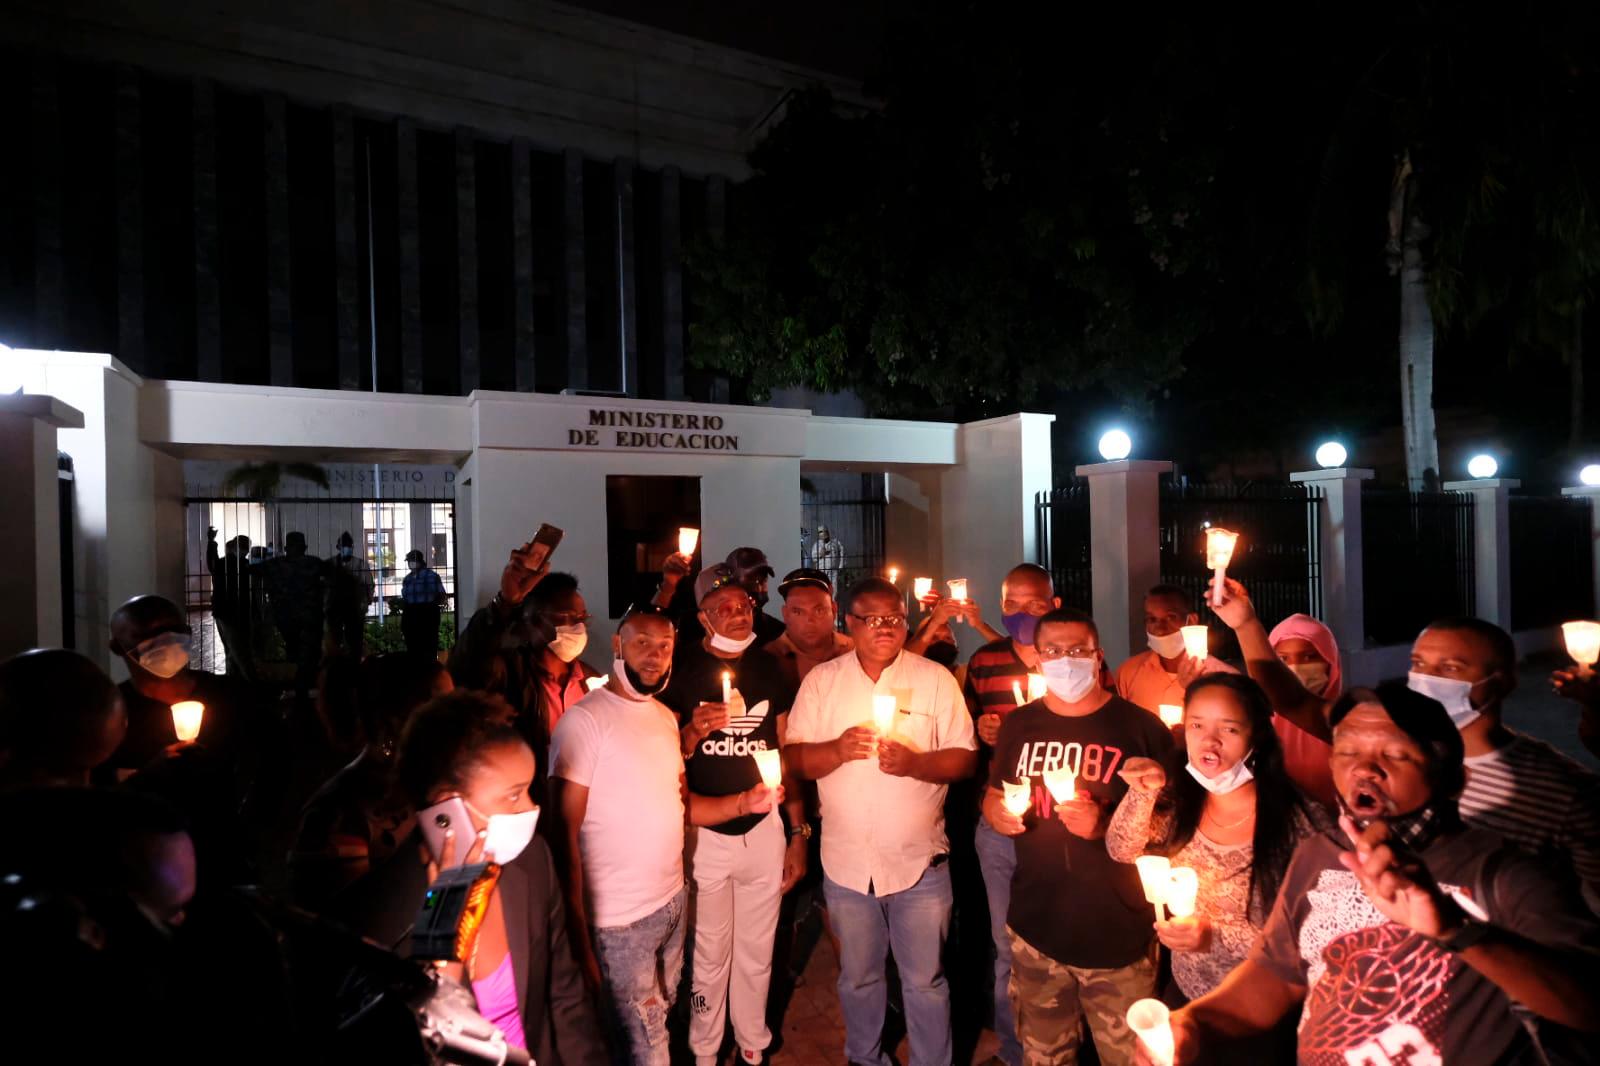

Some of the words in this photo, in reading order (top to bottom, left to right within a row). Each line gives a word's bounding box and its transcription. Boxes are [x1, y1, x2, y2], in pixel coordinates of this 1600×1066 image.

[588, 409, 724, 431] MINISTERIO
[568, 429, 599, 446] DE
[615, 431, 738, 450] EDUCACION
[327, 469, 424, 483] INISTERIO
[701, 737, 767, 757] adidas
[1016, 741, 1123, 785] AERO87
